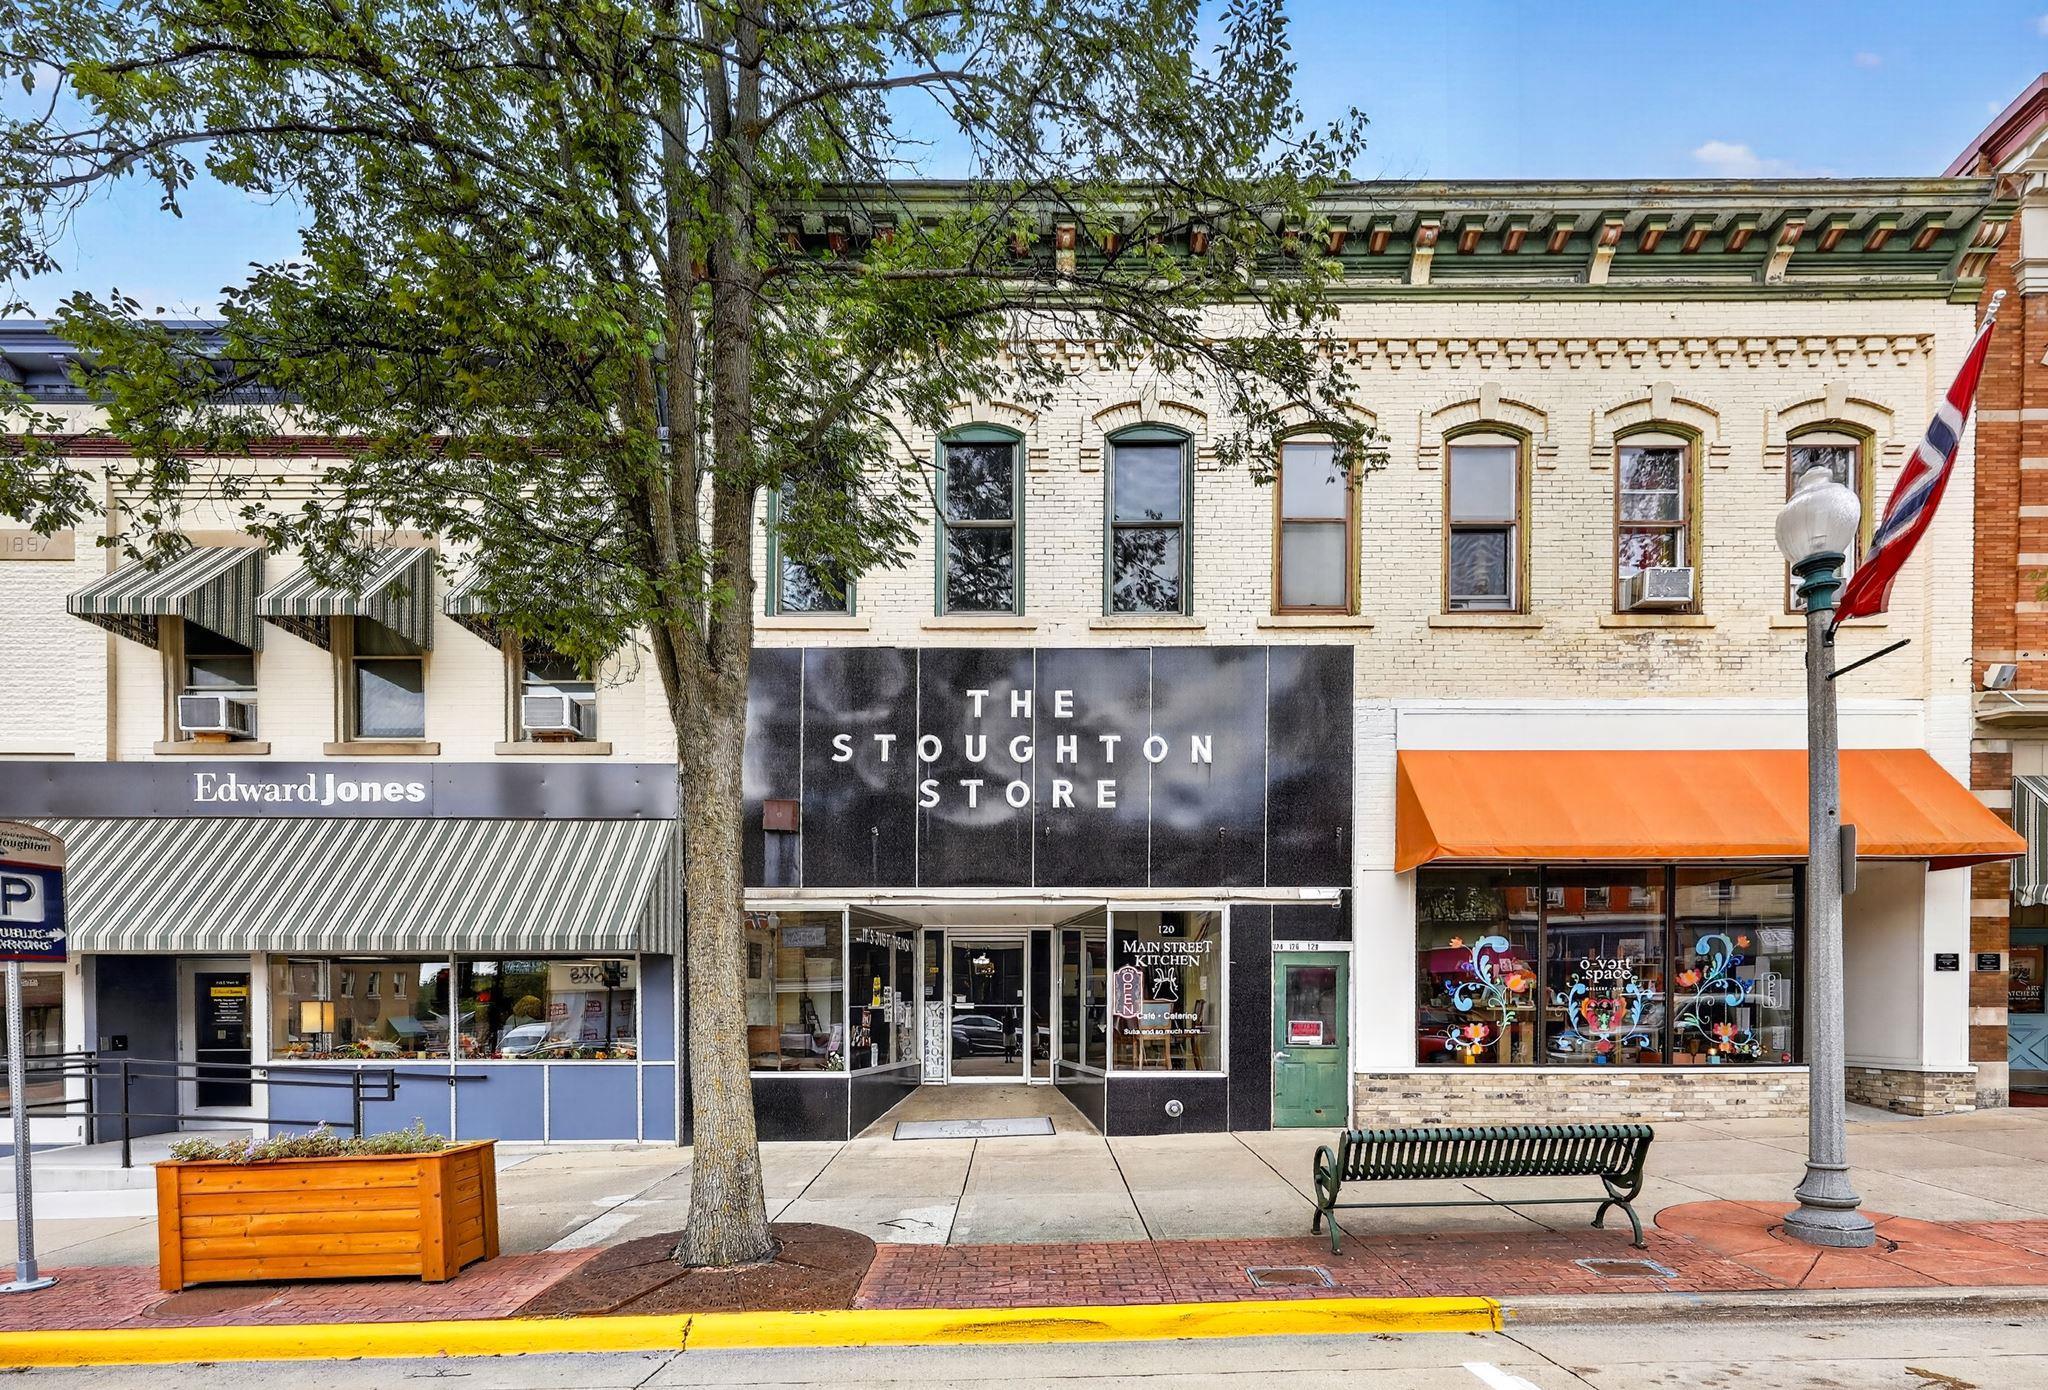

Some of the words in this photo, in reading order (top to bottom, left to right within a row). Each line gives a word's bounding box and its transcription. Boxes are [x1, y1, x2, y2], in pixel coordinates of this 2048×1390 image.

[6, 536, 50, 552] 1897
[966, 690, 1074, 718] THE
[831, 734, 1213, 764] STOUGHTON
[193, 772, 319, 802] Edward
[320, 773, 426, 806] Jones
[919, 779, 1116, 809] STORE
[0, 838, 51, 852] oughton
[1, 876, 35, 916] P
[0, 928, 46, 939] UBLIC
[1158, 925, 1175, 934] 120
[0, 939, 52, 951] ARKING
[1122, 939, 1160, 953] MAIN
[1163, 939, 1213, 953] STREET
[1135, 954, 1200, 967] KITCHEN
[1122, 972, 1134, 1015] OPEN
[1767, 974, 1776, 1007] OPEN
[1163, 1011, 1198, 1021] Catering
